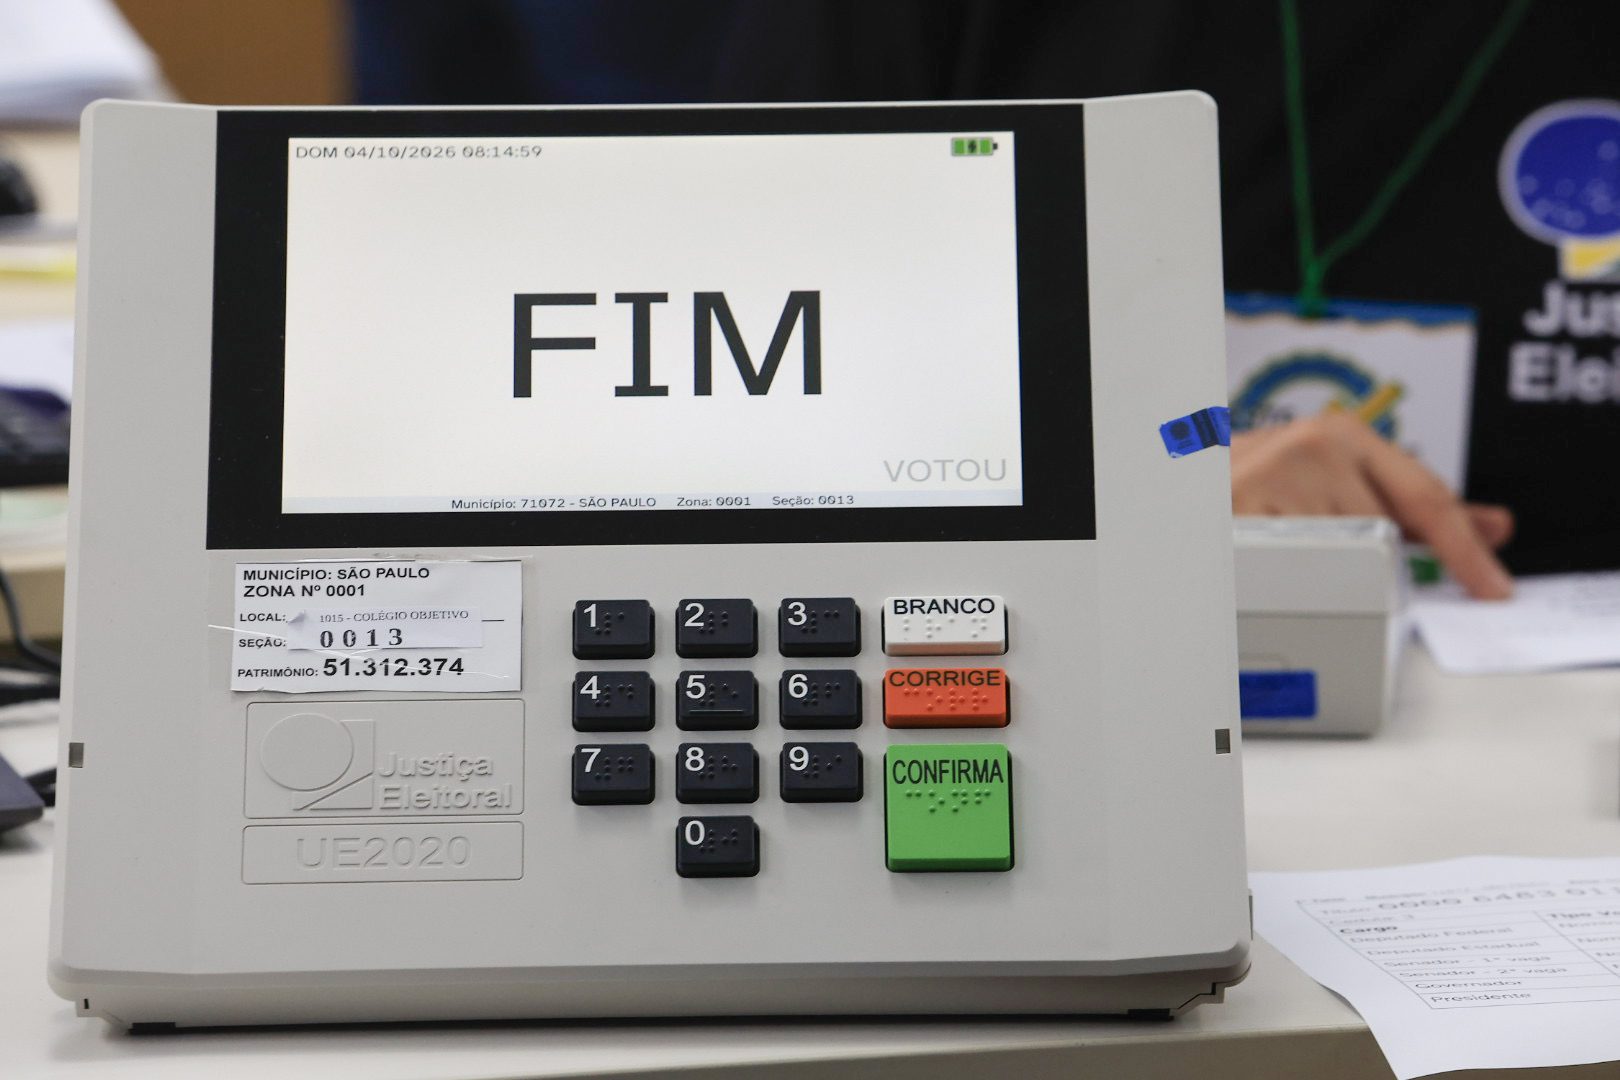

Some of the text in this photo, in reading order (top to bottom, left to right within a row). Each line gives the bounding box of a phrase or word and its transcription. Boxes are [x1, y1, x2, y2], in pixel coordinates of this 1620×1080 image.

[296, 145, 543, 159] DOM 04/10/2026 08:14:59
[513, 290, 822, 398] FIM
[883, 458, 1007, 483] VOTOU
[451, 498, 516, 510] Município:
[521, 498, 565, 508] 71072
[579, 496, 607, 508] SÃO
[612, 497, 657, 507] PAULO
[676, 496, 751, 507] Zona: 0001
[772, 495, 854, 508] Seção: 0013
[243, 565, 430, 581] MUNICÍPIO: SÃO PAULO
[243, 585, 295, 597] ZONA
[326, 584, 365, 597] 0001
[239, 612, 286, 623] LOCAL:
[320, 614, 344, 623] 1015
[353, 610, 408, 622] COLÉGIO
[410, 610, 469, 621] OBJETIVO
[583, 604, 598, 627] 1
[684, 603, 704, 627] 2
[788, 602, 808, 626] 3
[893, 598, 996, 615] BRANCO
[238, 637, 286, 649] SEÇÃO:
[237, 657, 464, 678] PATRIMÔNIO: 51.312.374
[888, 670, 1002, 687] CORRIGE
[580, 676, 601, 699] 4
[686, 674, 706, 698] 5
[788, 674, 808, 698] 6
[377, 752, 494, 782] Justiça
[581, 748, 601, 772] 7
[684, 747, 706, 772] 8
[789, 746, 810, 771] 9
[892, 759, 1004, 784] CONFIRMA
[379, 783, 513, 811] Eleitoral
[684, 821, 706, 845] 0
[297, 836, 471, 871] UE2020
[1340, 925, 1398, 934] Cargo
[1350, 927, 1513, 943] Deputado Federal
[1415, 980, 1522, 989] Governador
[1431, 992, 1531, 1004] Presidente
